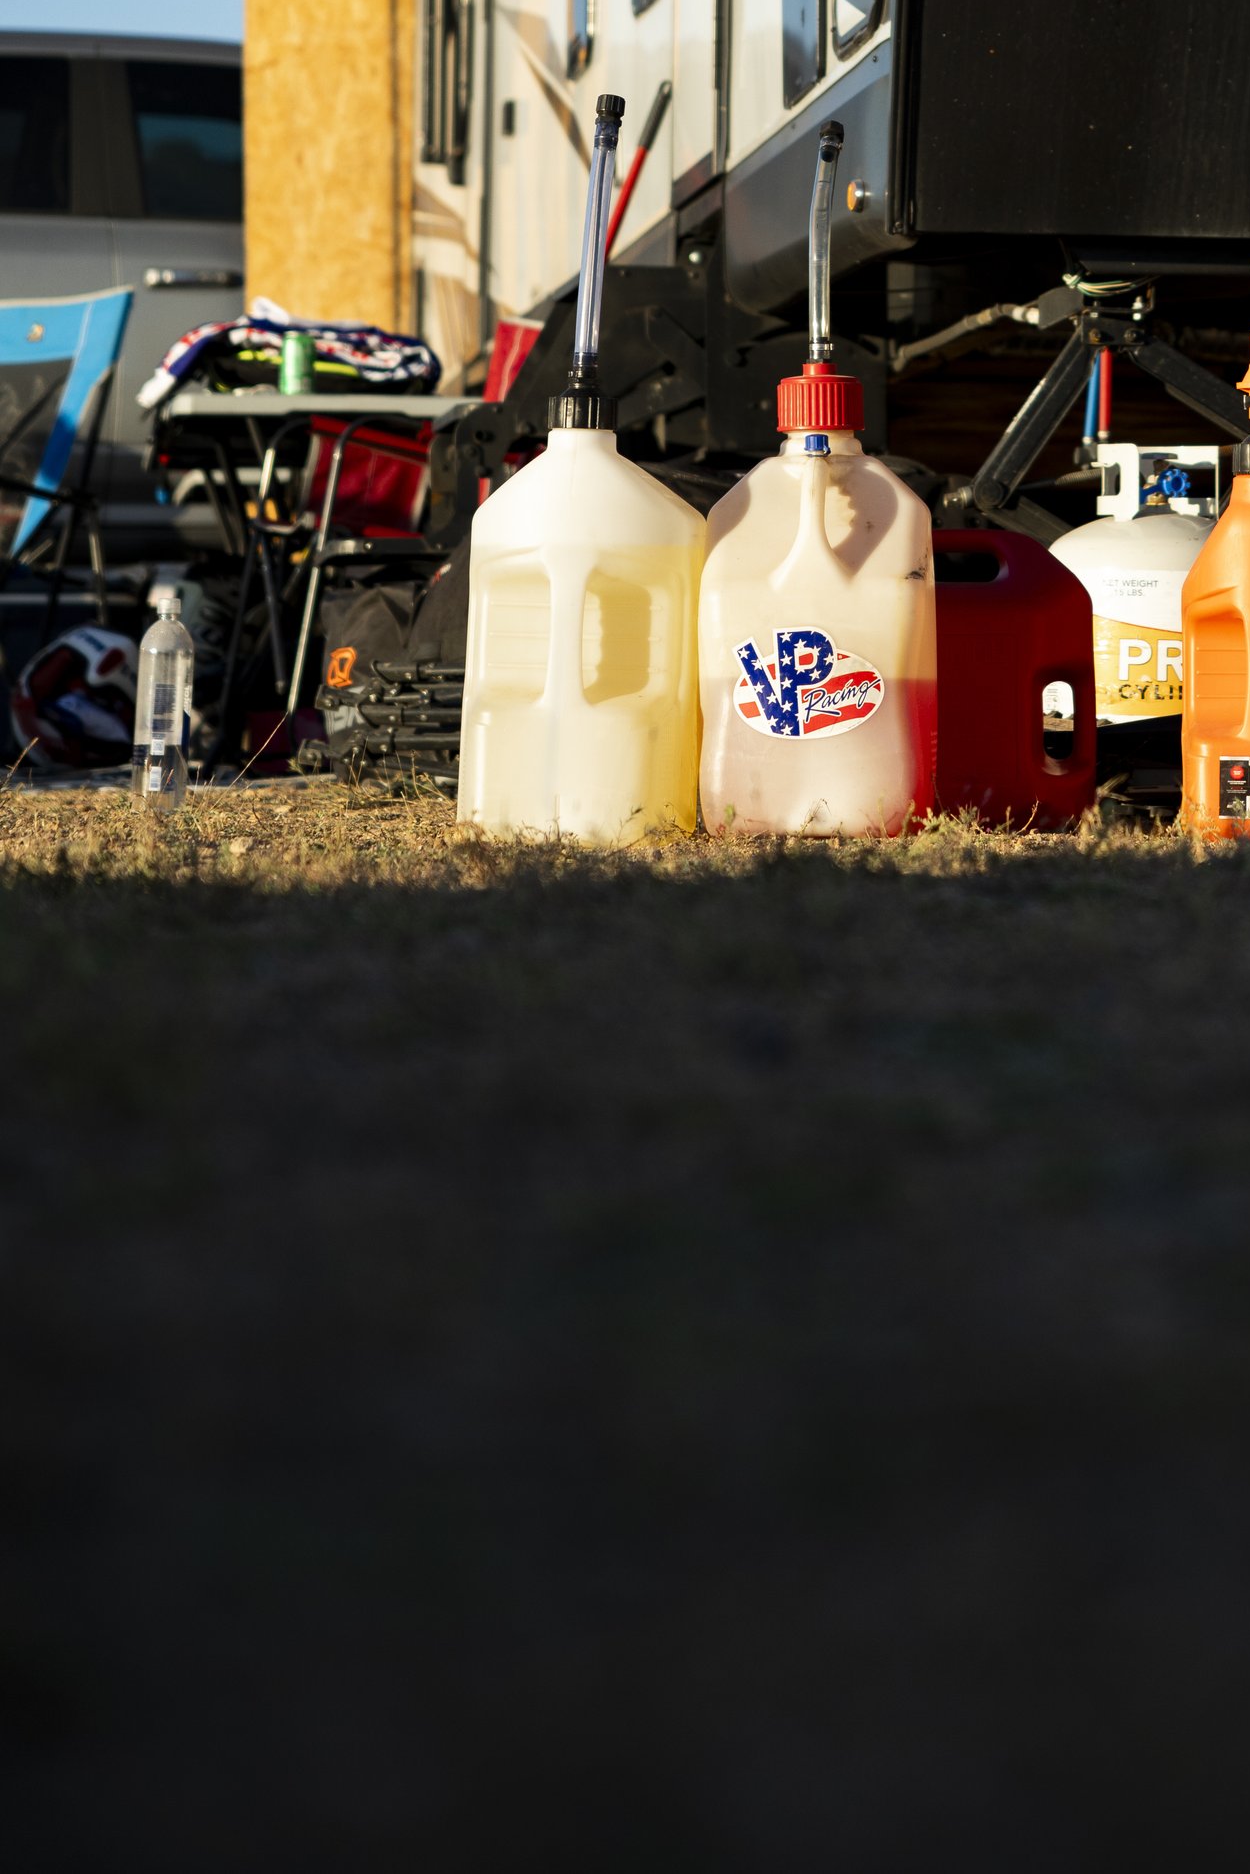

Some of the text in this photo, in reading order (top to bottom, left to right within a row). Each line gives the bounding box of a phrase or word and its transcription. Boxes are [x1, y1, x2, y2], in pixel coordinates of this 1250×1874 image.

[1122, 579, 1159, 588] WEIGHT
[737, 630, 881, 737] VP Racing
